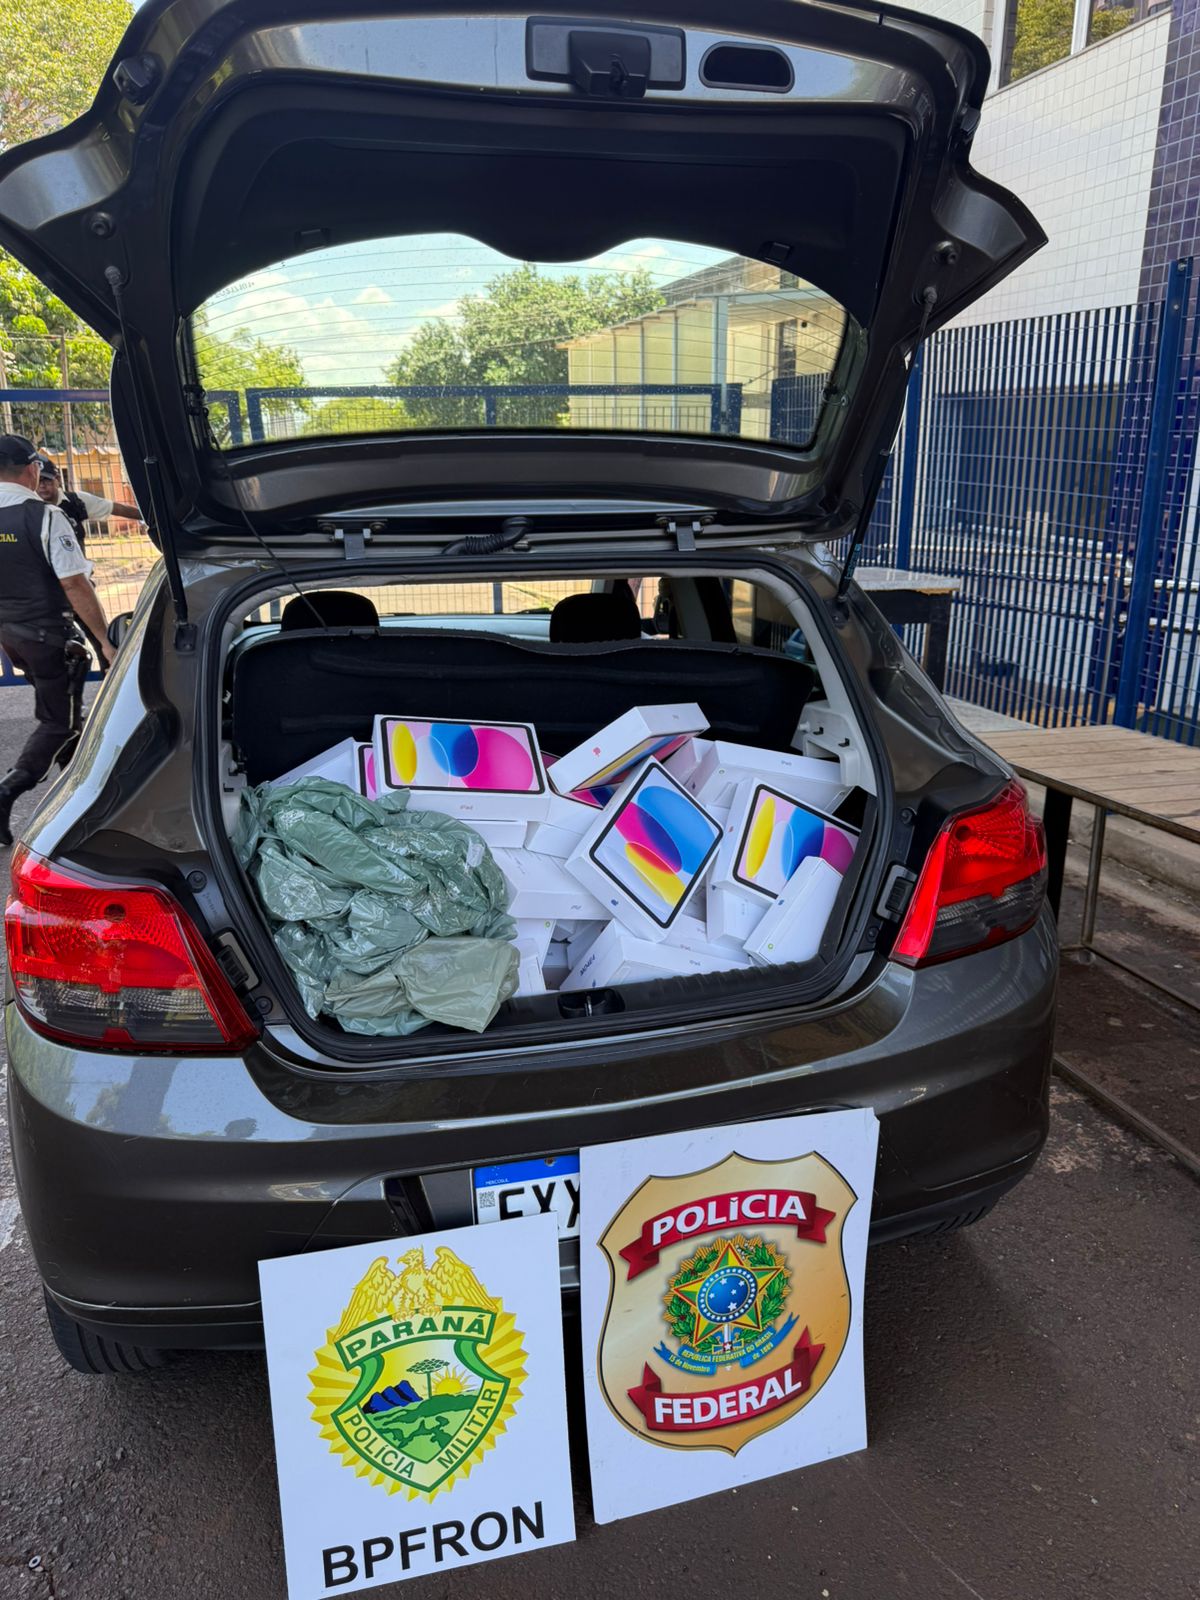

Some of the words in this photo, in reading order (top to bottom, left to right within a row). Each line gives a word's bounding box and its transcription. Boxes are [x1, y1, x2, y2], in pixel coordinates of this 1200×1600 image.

[652, 1194, 807, 1247] POLÍCIA
[347, 1313, 489, 1360] PARANÁ
[668, 1354, 674, 1362] 15
[682, 1361, 710, 1373] Novembro
[752, 1352, 760, 1360] de
[712, 1349, 746, 1362] FEDERATIVA
[746, 1344, 755, 1353] DO
[755, 1331, 773, 1348] BRASIL
[654, 1368, 802, 1425] FEDERAL
[342, 1414, 416, 1478] POLÍCIA
[440, 1386, 501, 1469] MILITAR
[322, 1501, 545, 1589] BPFRON
